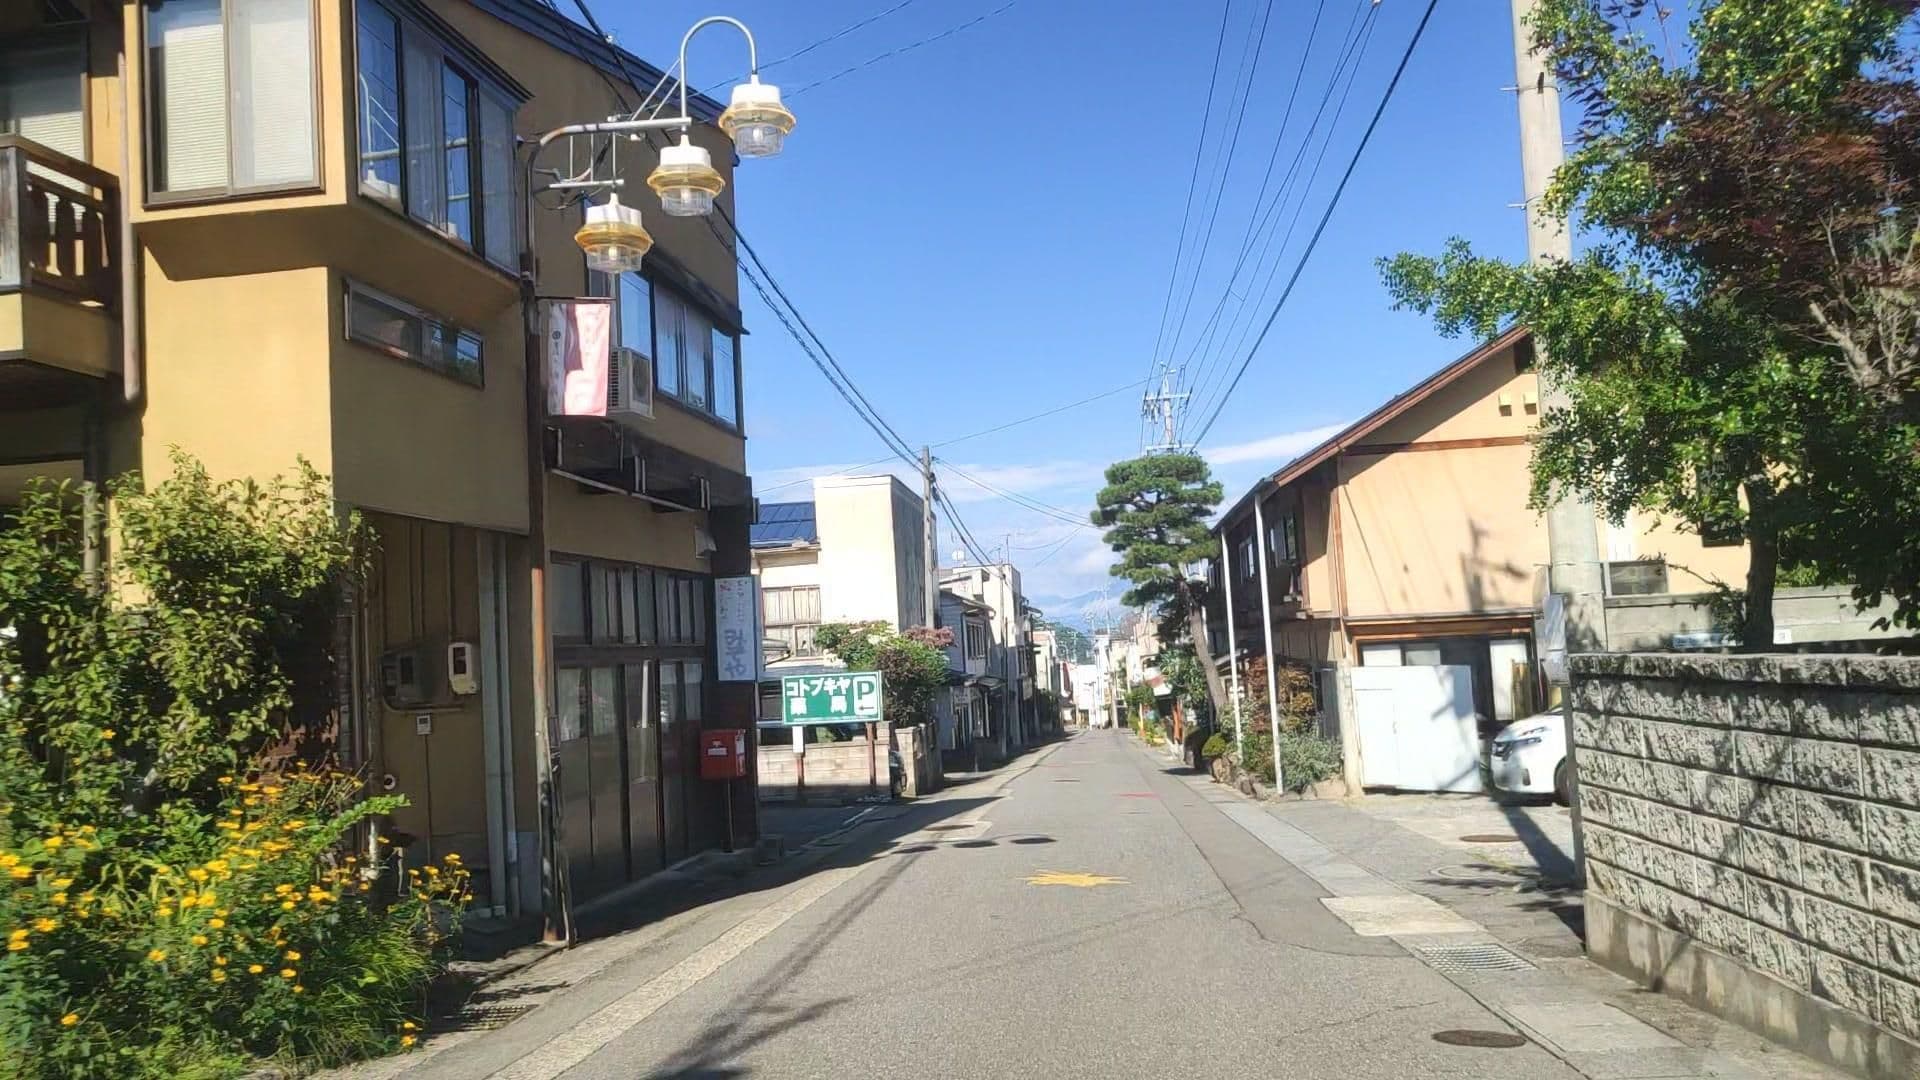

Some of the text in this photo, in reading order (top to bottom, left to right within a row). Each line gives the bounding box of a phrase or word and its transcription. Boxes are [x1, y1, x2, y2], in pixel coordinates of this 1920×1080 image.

[786, 677, 851, 697] コトブキヤ
[857, 680, 875, 700] P
